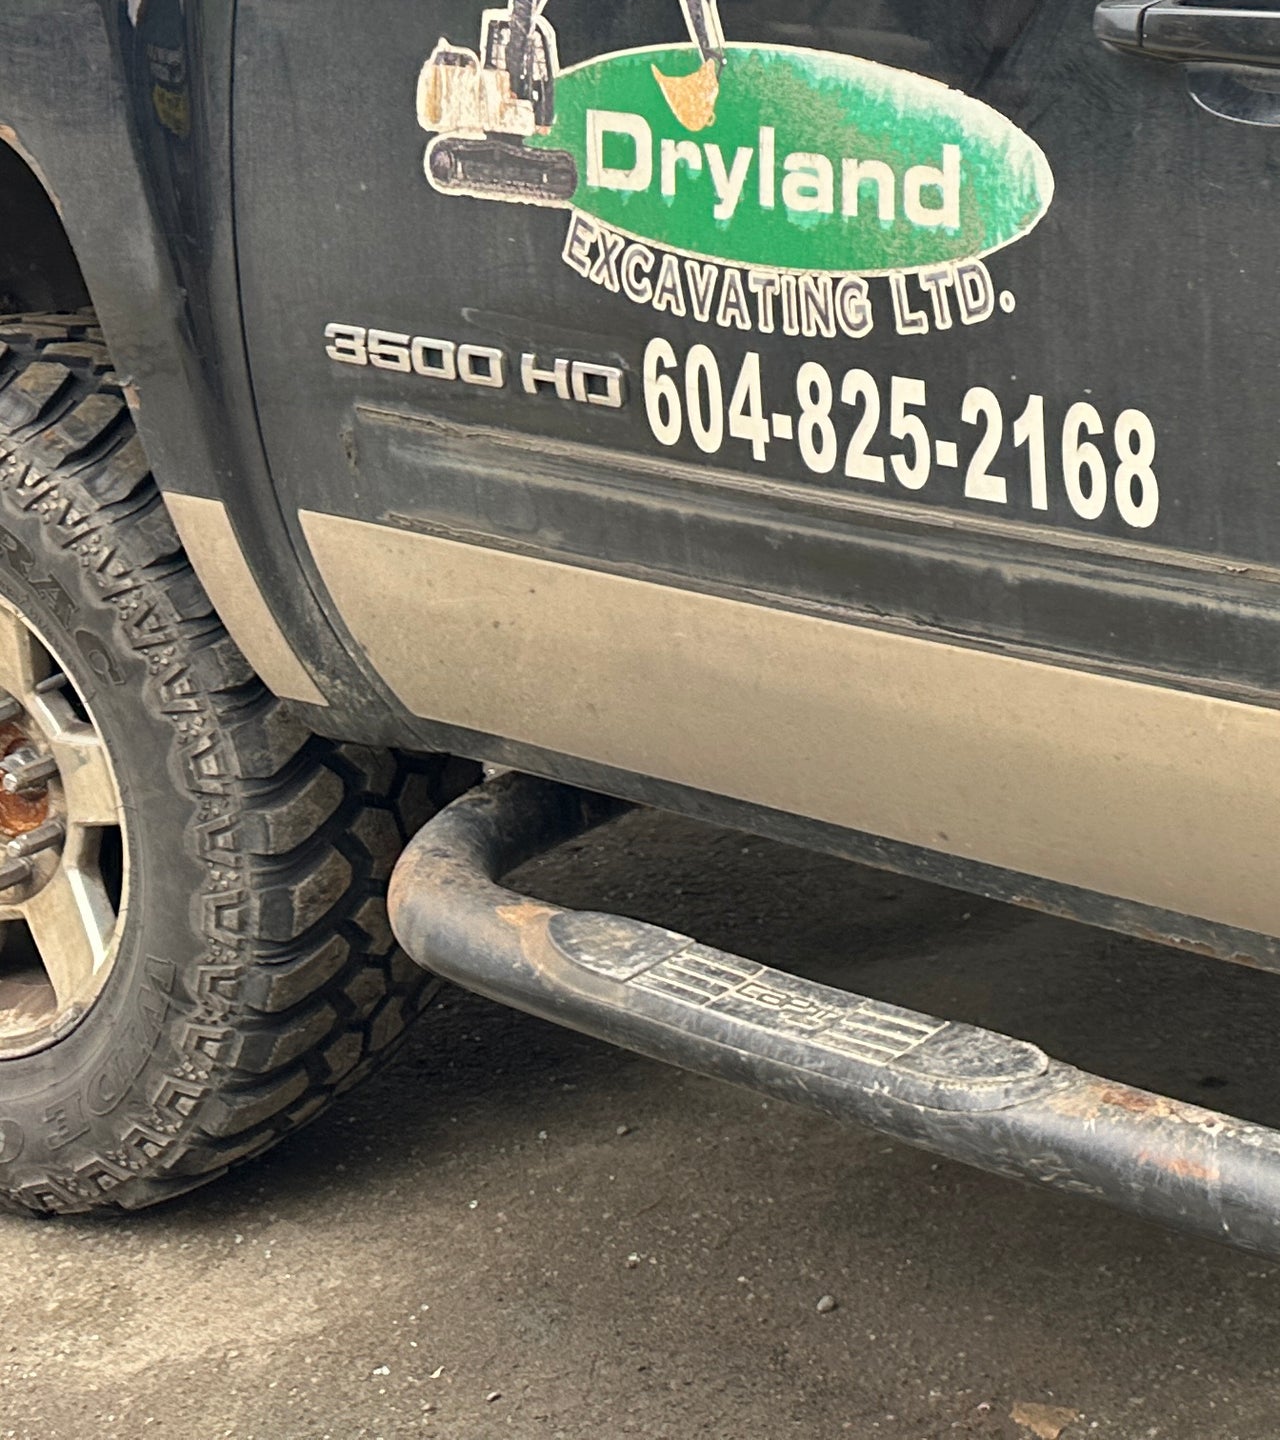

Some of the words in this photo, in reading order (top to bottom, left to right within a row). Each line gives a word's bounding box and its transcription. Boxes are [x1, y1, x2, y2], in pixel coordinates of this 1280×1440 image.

[585, 108, 962, 230] Dryland
[561, 208, 873, 338] EXCAVATING
[889, 257, 1017, 334] LTD.
[324, 322, 506, 389] 3500
[520, 352, 625, 409] HD
[642, 336, 1160, 529] 604-825-2168
